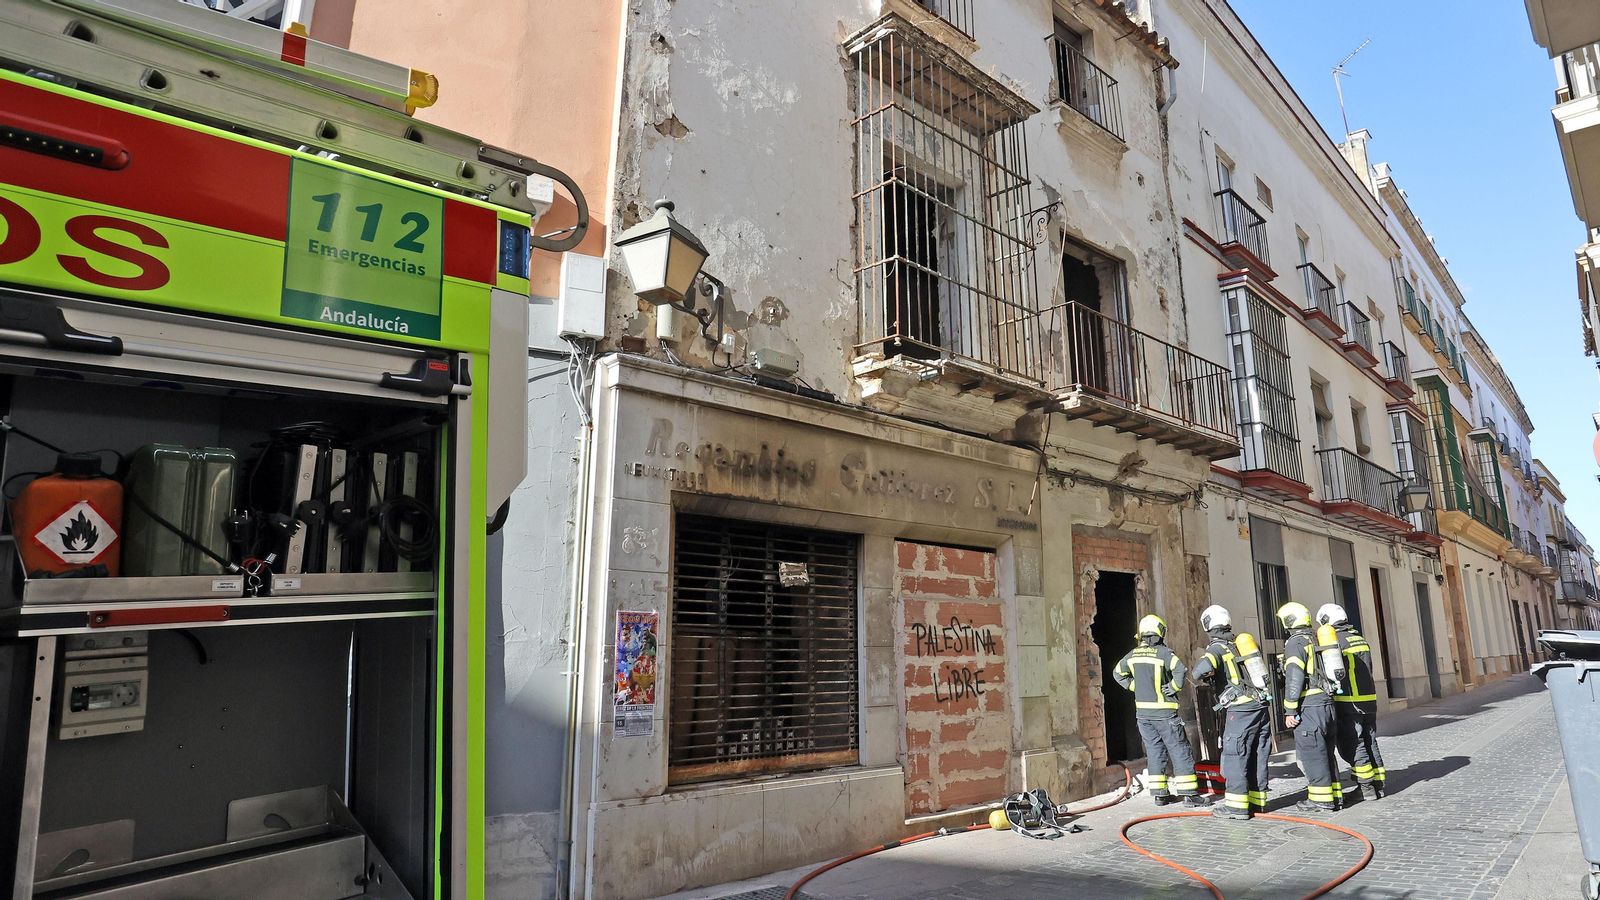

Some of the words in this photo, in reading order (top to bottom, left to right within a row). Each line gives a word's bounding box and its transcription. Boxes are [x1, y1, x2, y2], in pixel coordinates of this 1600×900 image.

[312, 192, 430, 254] 112
[308, 239, 426, 276] Emergencias
[320, 306, 409, 334] Andalucía
[911, 616, 996, 658] PALESTINA
[933, 665, 986, 703] LIBRE
